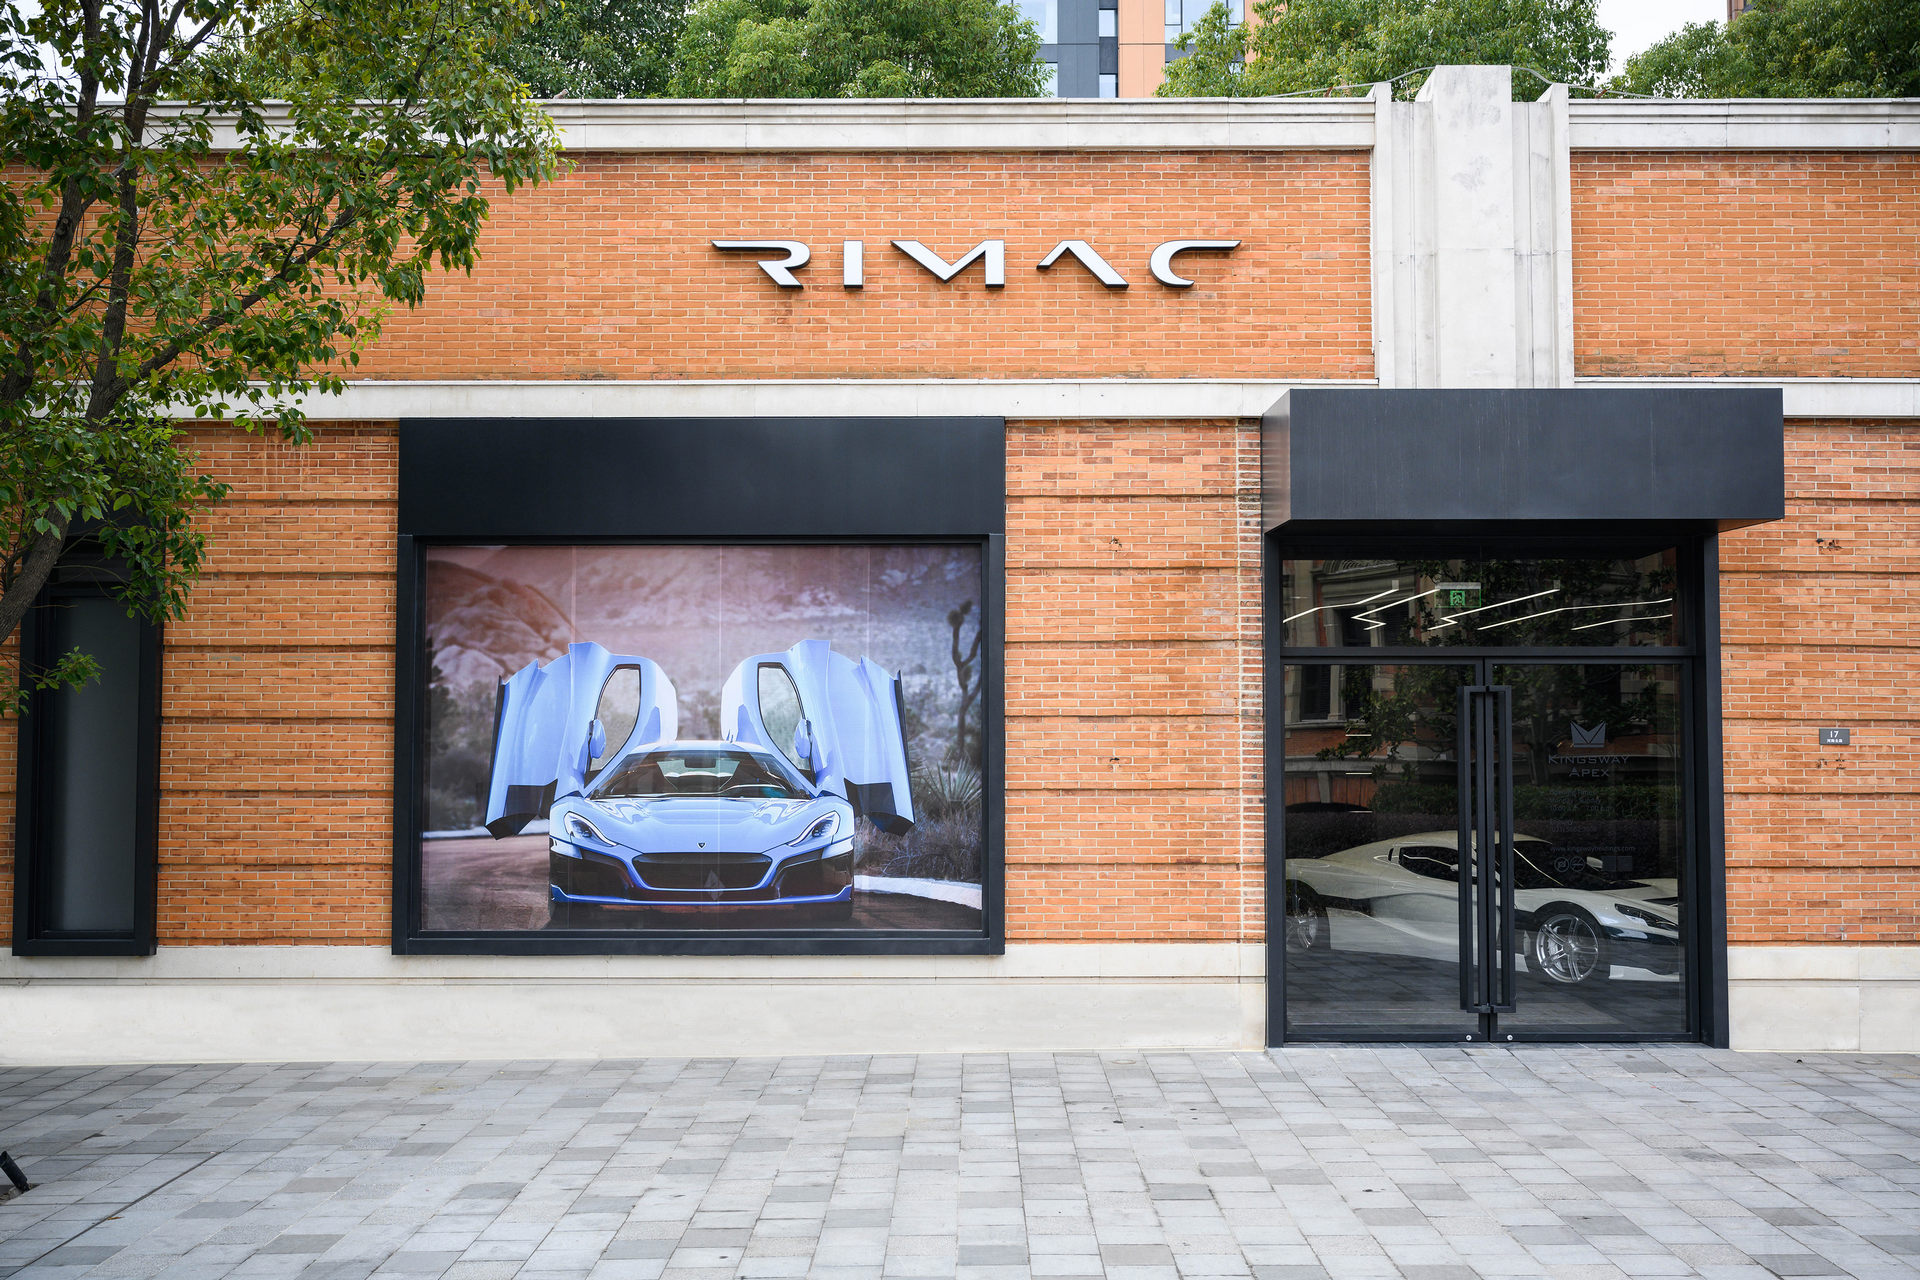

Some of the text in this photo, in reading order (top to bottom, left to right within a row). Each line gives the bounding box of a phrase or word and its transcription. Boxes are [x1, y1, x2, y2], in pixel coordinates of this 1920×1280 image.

[711, 240, 1242, 289] RIMAC
[1830, 730, 1839, 738] 17
[1548, 754, 1629, 764] KINGSWAY
[1569, 767, 1609, 777] APEX
